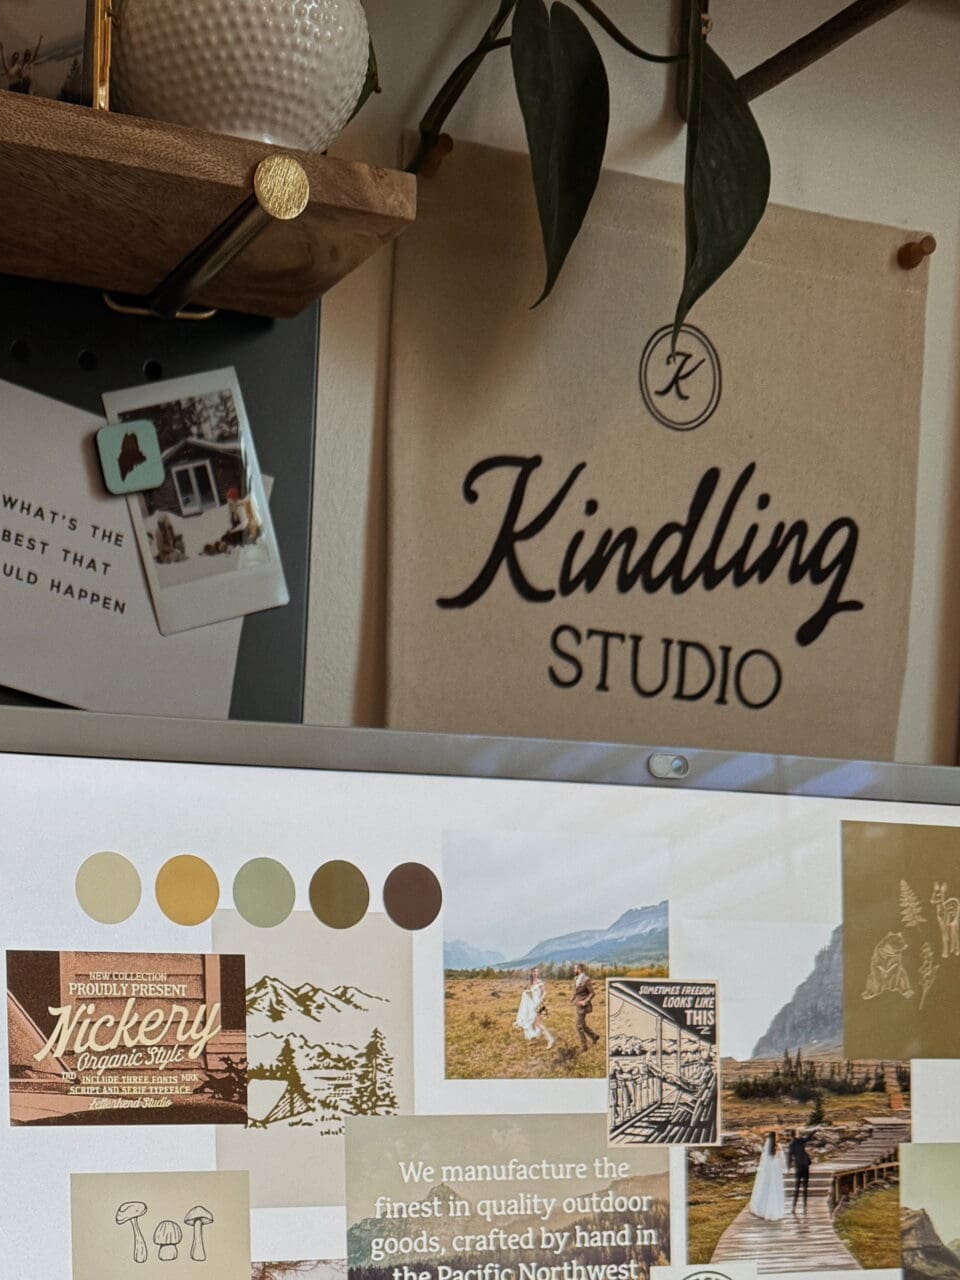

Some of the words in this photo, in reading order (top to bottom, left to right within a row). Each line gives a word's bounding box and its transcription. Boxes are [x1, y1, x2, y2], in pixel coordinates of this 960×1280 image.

[653, 351, 706, 401] K
[2, 494, 78, 531] WHAT'S
[90, 525, 125, 547] THE
[1, 528, 50, 555] BEST
[62, 548, 112, 576] THAT
[435, 454, 865, 647] Kindling
[49, 578, 126, 614] HAPPEN
[547, 623, 783, 710] STUDIO
[68, 982, 128, 996] PROUDLY
[131, 983, 188, 997] PRESENT
[89, 971, 111, 981] NEW
[112, 971, 167, 982] COLLECTION
[638, 985, 680, 995] SOMETIMES
[681, 985, 715, 996] FREEDOM
[662, 996, 693, 1009] LOOKS
[694, 997, 715, 1009] LIKE
[684, 1009, 715, 1026] THIS
[33, 997, 222, 1062] Nickery
[77, 1048, 144, 1076] Organic
[144, 1043, 185, 1071] Style
[69, 1086, 100, 1094] SCRIPT
[102, 1086, 119, 1094] AND
[149, 1086, 190, 1094] TYPEFACE
[82, 1075, 119, 1084] INCLUDE
[121, 1075, 149, 1084] THREE
[151, 1075, 178, 1084] FONTS
[398, 1161, 435, 1183] We
[440, 1158, 588, 1183] manufacture
[592, 1156, 631, 1179] the
[374, 1196, 443, 1219] finest
[447, 1196, 471, 1218] in
[477, 1192, 556, 1222] quality
[562, 1190, 653, 1214] outdoor
[370, 1230, 447, 1261] goods,
[452, 1226, 535, 1251] crafted
[539, 1226, 570, 1255] by
[574, 1224, 632, 1249] hand
[636, 1224, 659, 1246] in
